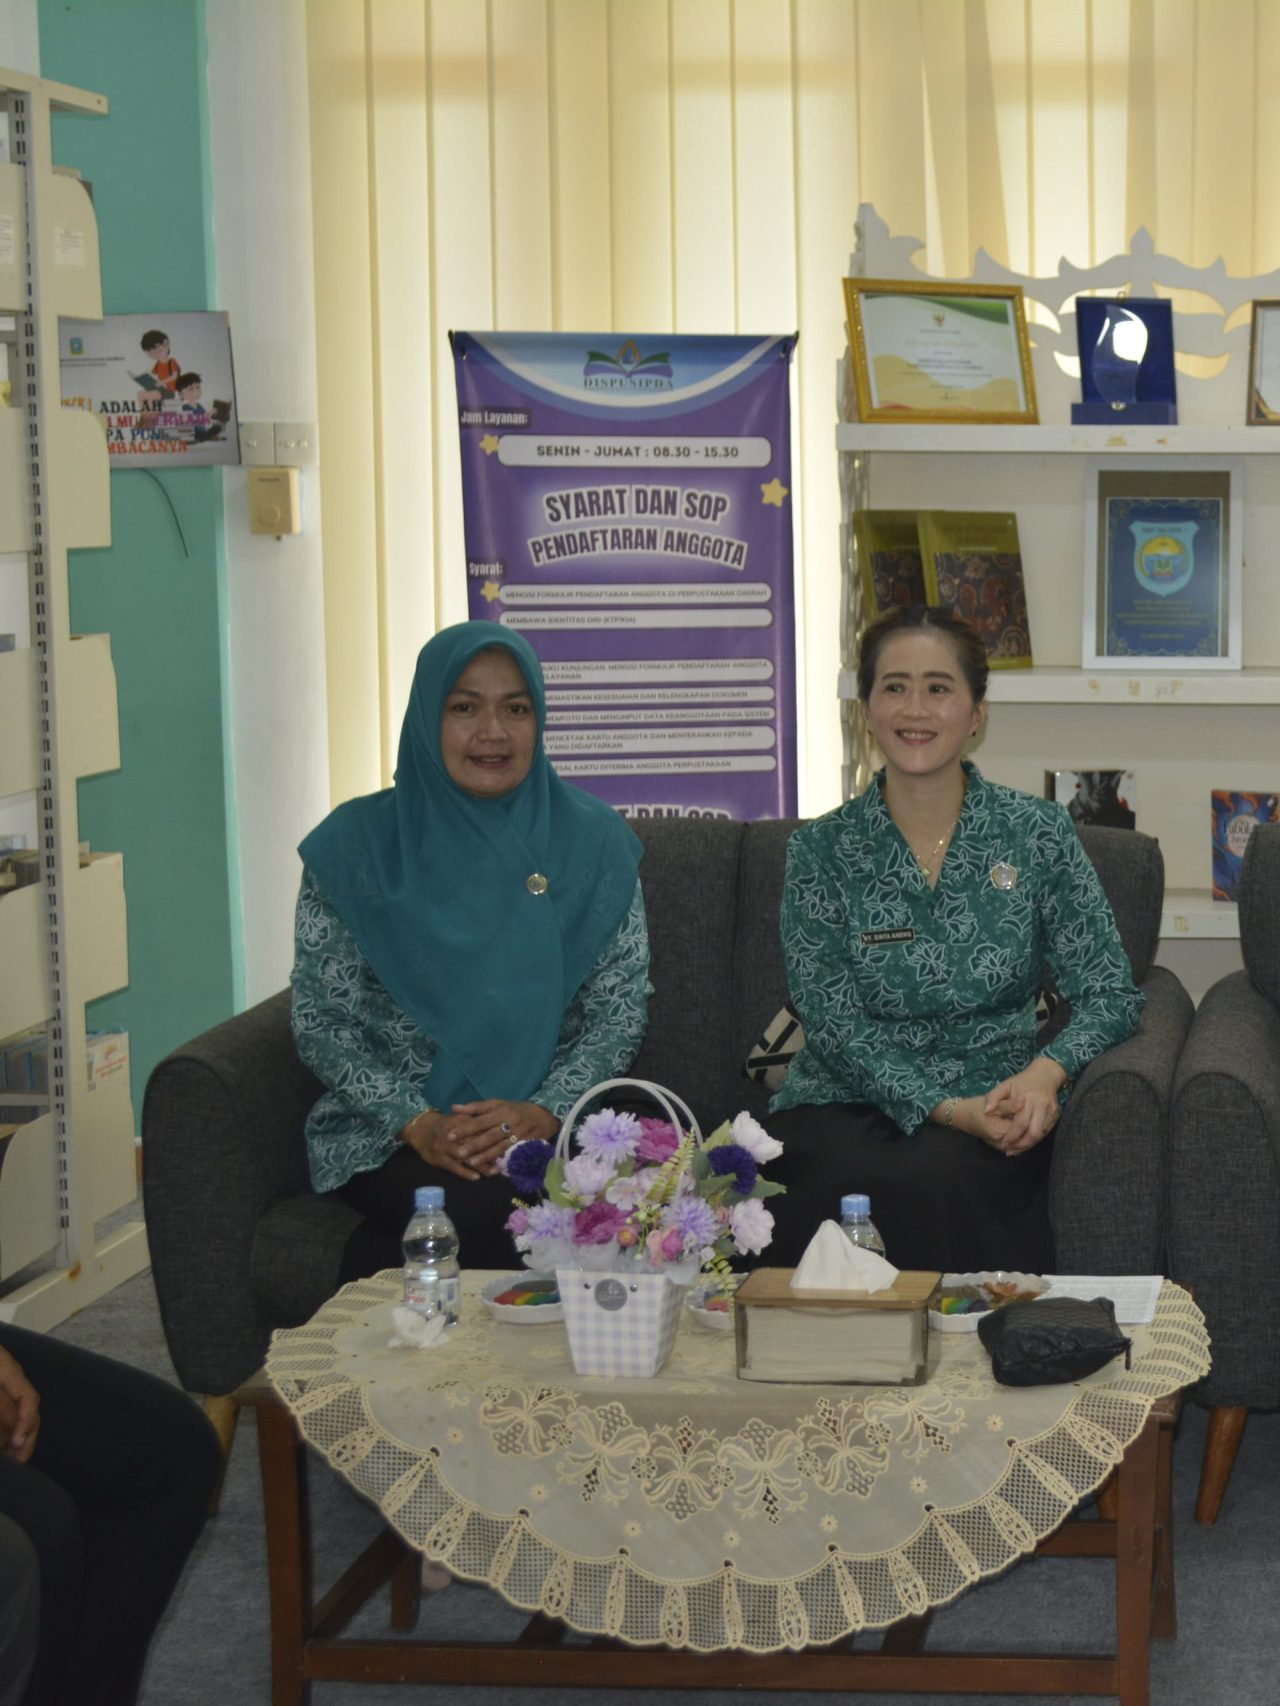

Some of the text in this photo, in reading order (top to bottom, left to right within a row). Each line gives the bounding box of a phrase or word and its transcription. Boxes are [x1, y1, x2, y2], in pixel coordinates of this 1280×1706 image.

[99, 400, 162, 413] ADALAH
[460, 411, 528, 426] Jam Layanan:
[131, 428, 161, 440] PUN
[536, 445, 580, 457] SENIN
[594, 446, 641, 457] JUMAT
[653, 446, 691, 458] 08.30
[703, 446, 739, 458] 15.30
[544, 487, 728, 523] SYARAT DAN SOP
[529, 527, 747, 567] PENDAFTARAN ANGGOTA
[469, 563, 503, 576] Syarat:
